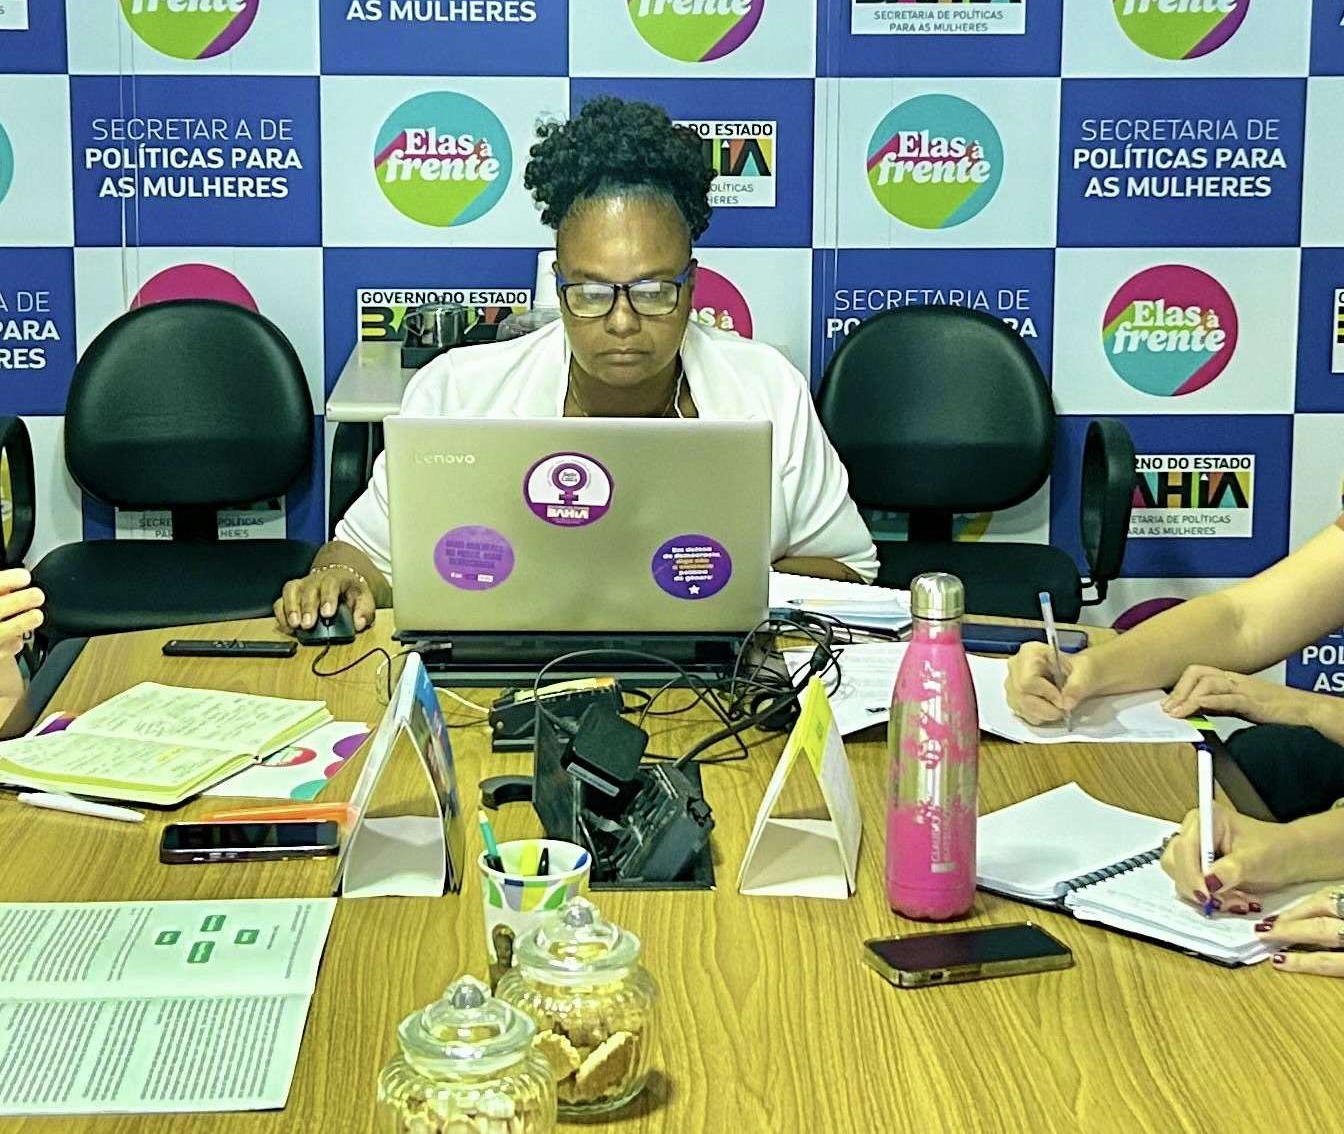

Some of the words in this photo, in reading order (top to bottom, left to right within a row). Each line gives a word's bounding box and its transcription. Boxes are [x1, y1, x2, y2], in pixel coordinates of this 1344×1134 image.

[347, 0, 382, 21] AS
[390, 0, 537, 21] MULHERES
[874, 11, 935, 20] SECRETARIA
[938, 11, 950, 20] DE
[890, 24, 915, 32] PARA
[918, 24, 931, 32] AS
[934, 23, 987, 32] MULHERES
[716, 124, 772, 136] ESTADO
[1081, 118, 1238, 141] SECRETARIA
[1247, 119, 1278, 139] DE
[896, 129, 967, 158] Elas
[1073, 143, 1208, 170] POLÍTICAS
[1216, 147, 1286, 168] PARA
[877, 151, 991, 186] frente
[710, 182, 754, 192] OLÍTICAS
[1085, 177, 1120, 197] AS
[1127, 176, 1271, 198] MULHERES
[17, 292, 50, 312] DE
[361, 292, 439, 304] GOVERNO
[469, 292, 527, 304] ESTADO
[998, 290, 1030, 310] DE
[1132, 298, 1202, 327] Elas
[1112, 320, 1226, 354] frente
[1168, 458, 1189, 470] DO
[1194, 458, 1251, 470] ESTADO
[1130, 472, 1249, 508] AHIA
[1131, 515, 1164, 524] ETARIA
[1166, 515, 1179, 524] DE
[1148, 526, 1160, 535] AS
[1163, 526, 1216, 535] MULHERES
